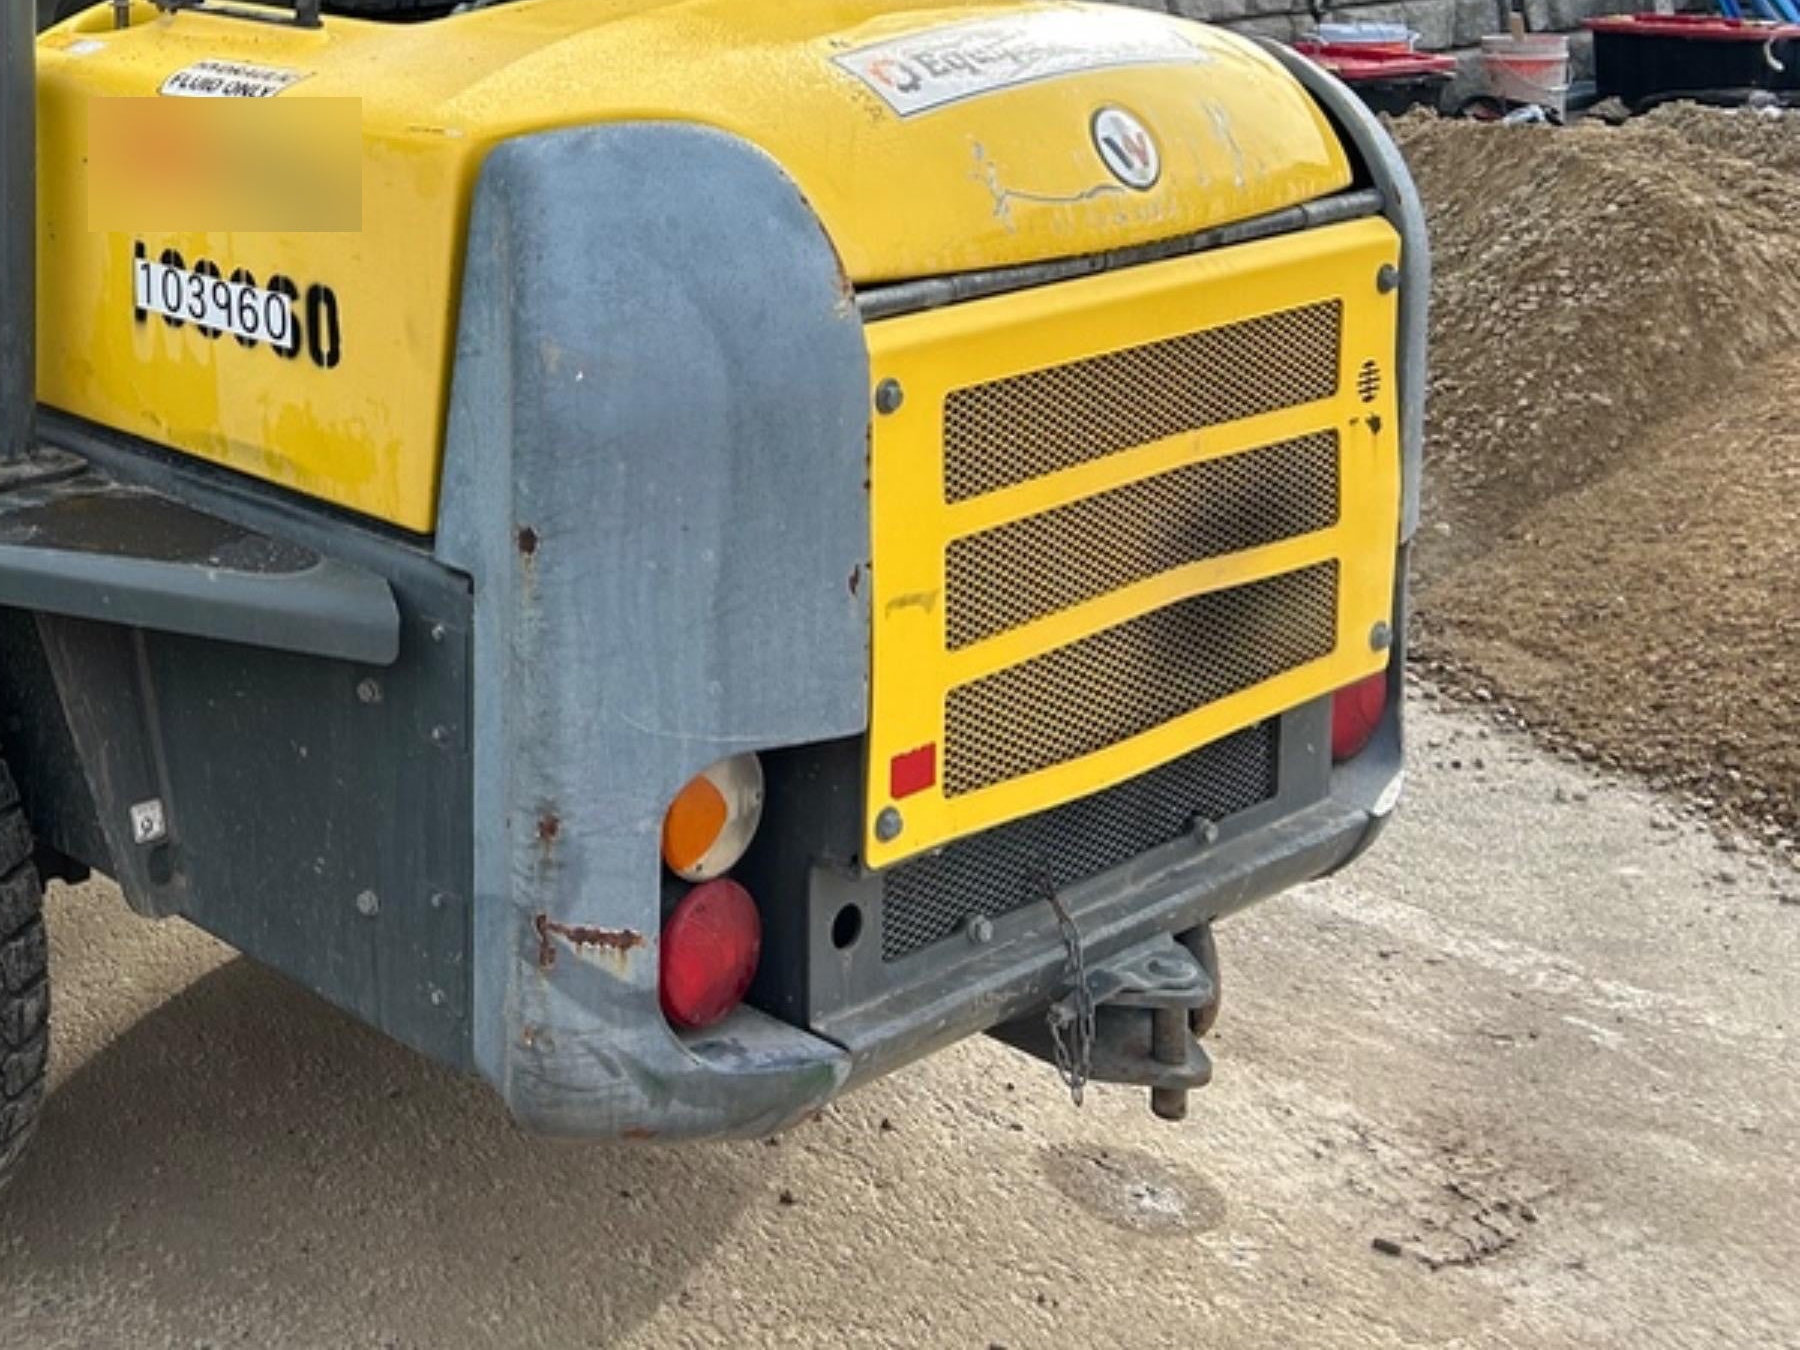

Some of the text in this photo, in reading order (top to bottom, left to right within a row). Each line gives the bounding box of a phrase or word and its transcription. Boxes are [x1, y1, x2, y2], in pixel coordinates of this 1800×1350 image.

[170, 71, 277, 98] FLUID ONLY
[138, 261, 288, 341] 103960
